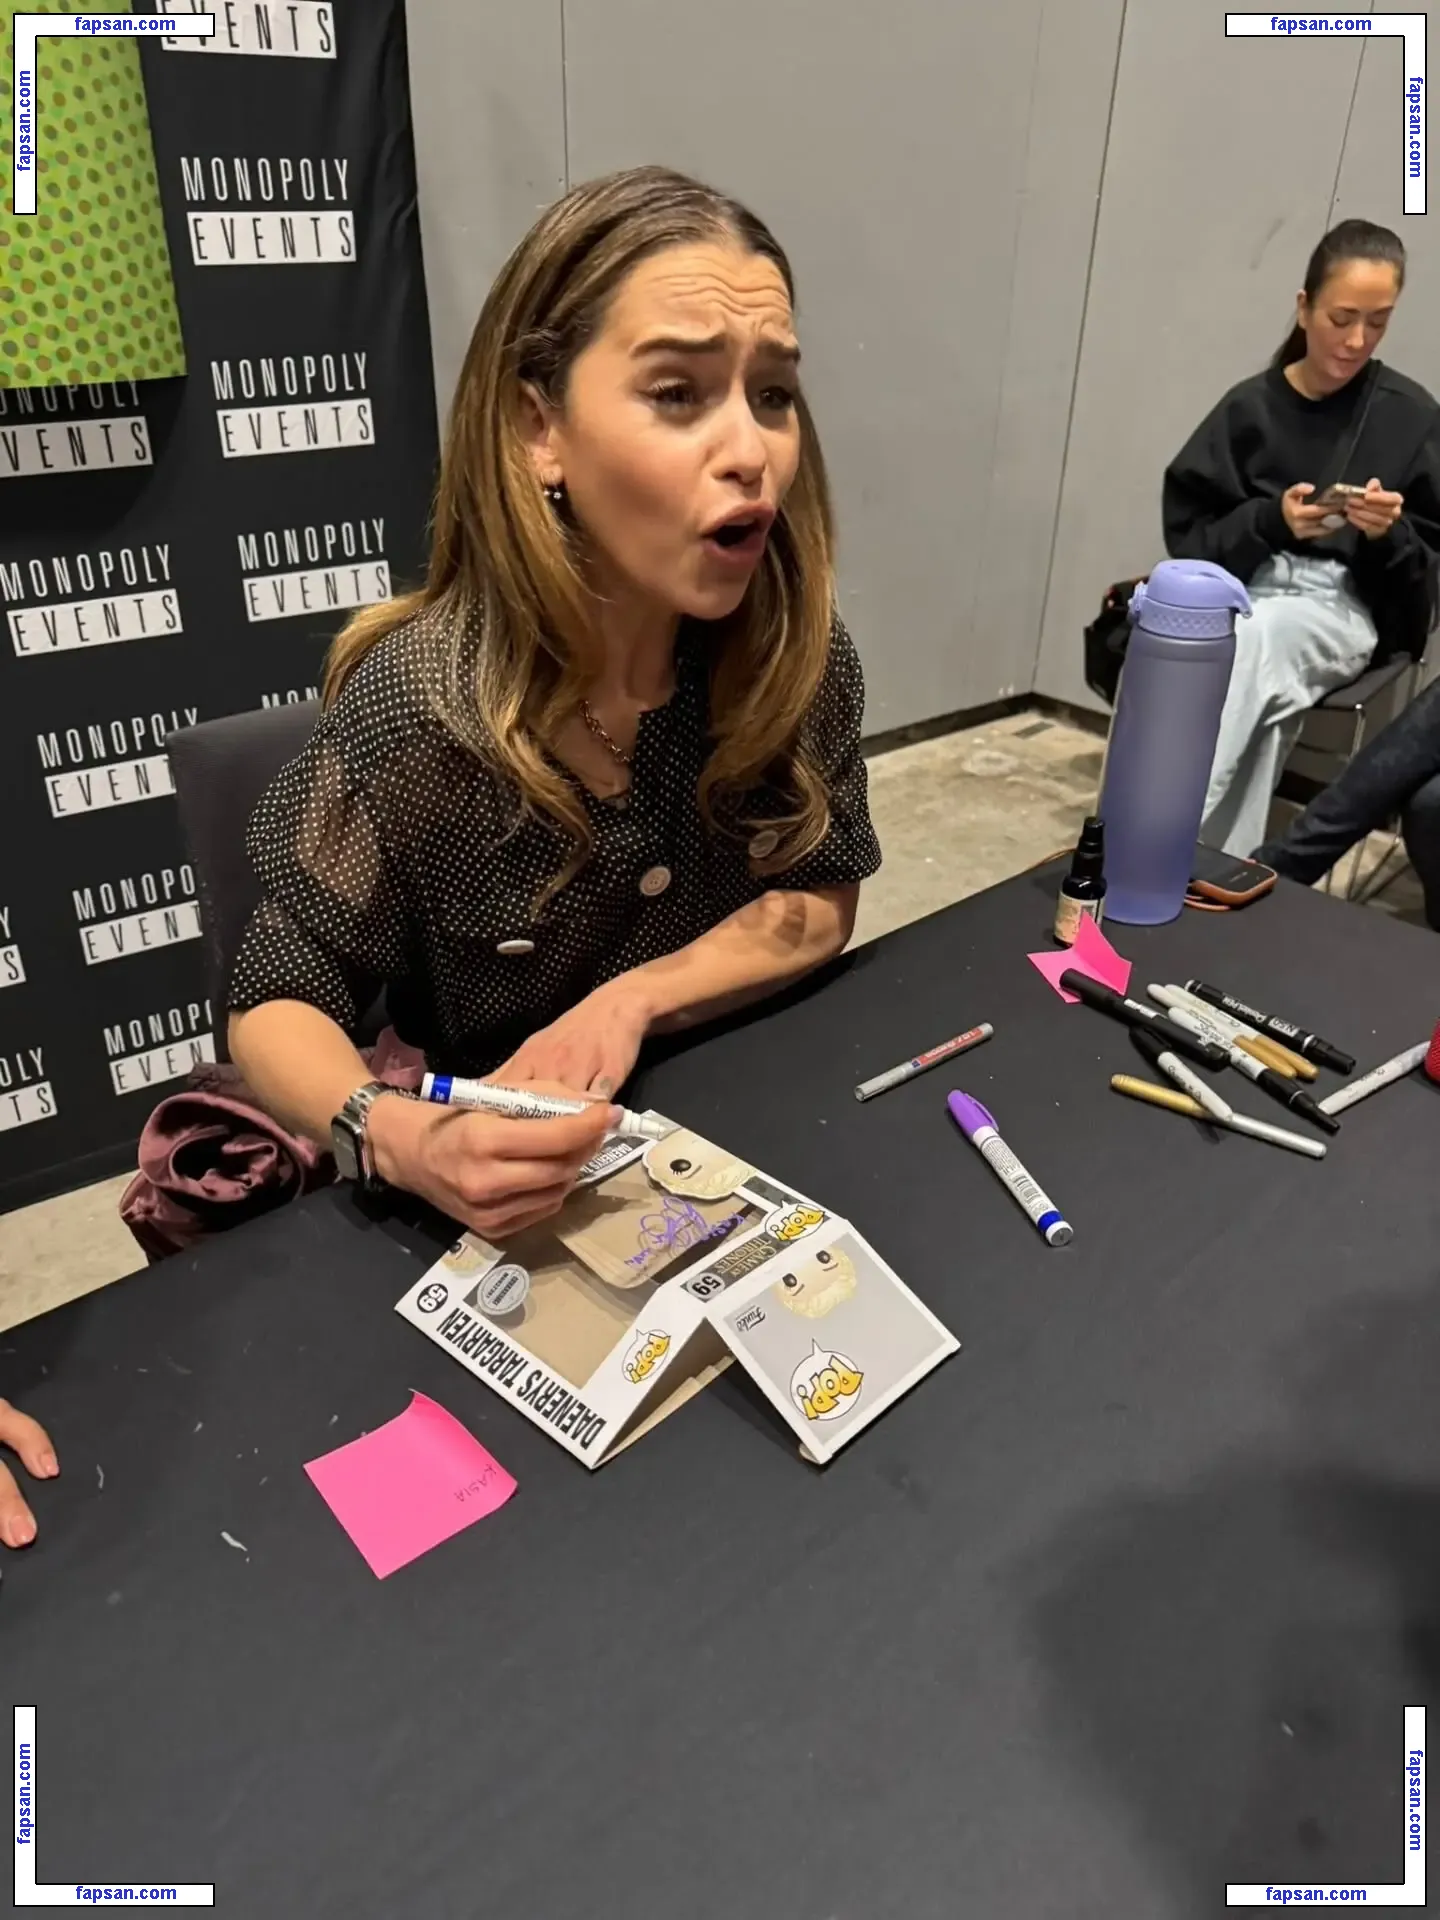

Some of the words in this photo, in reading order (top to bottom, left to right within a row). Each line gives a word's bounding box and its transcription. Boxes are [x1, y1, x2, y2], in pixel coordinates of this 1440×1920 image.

[181, 157, 348, 201] MONOPOLY
[194, 217, 352, 260] EVENTS
[211, 352, 367, 400] MONOPOLY
[1, 421, 147, 471] VENTS
[222, 404, 370, 453] EVENTS
[238, 518, 385, 571] MONOPOLY
[0, 544, 170, 602] MONOPOLY
[248, 566, 388, 617] EVENTS
[13, 594, 177, 651] EVENTS
[72, 864, 196, 921] MONOPO
[85, 904, 202, 960] EVENT
[115, 1040, 203, 1090] EVEN
[769, 1204, 826, 1241] POP!
[714, 1238, 772, 1272] THRONES
[740, 1246, 777, 1277] GAME
[418, 1284, 448, 1312] 59
[691, 1275, 721, 1296] 59
[736, 1306, 766, 1333] Funko
[436, 1307, 529, 1389] TARGARYEN
[625, 1333, 672, 1384] POP!
[516, 1369, 607, 1450] DAENERYS
[796, 1354, 865, 1421] POP!
[453, 1463, 498, 1503] KASIA
